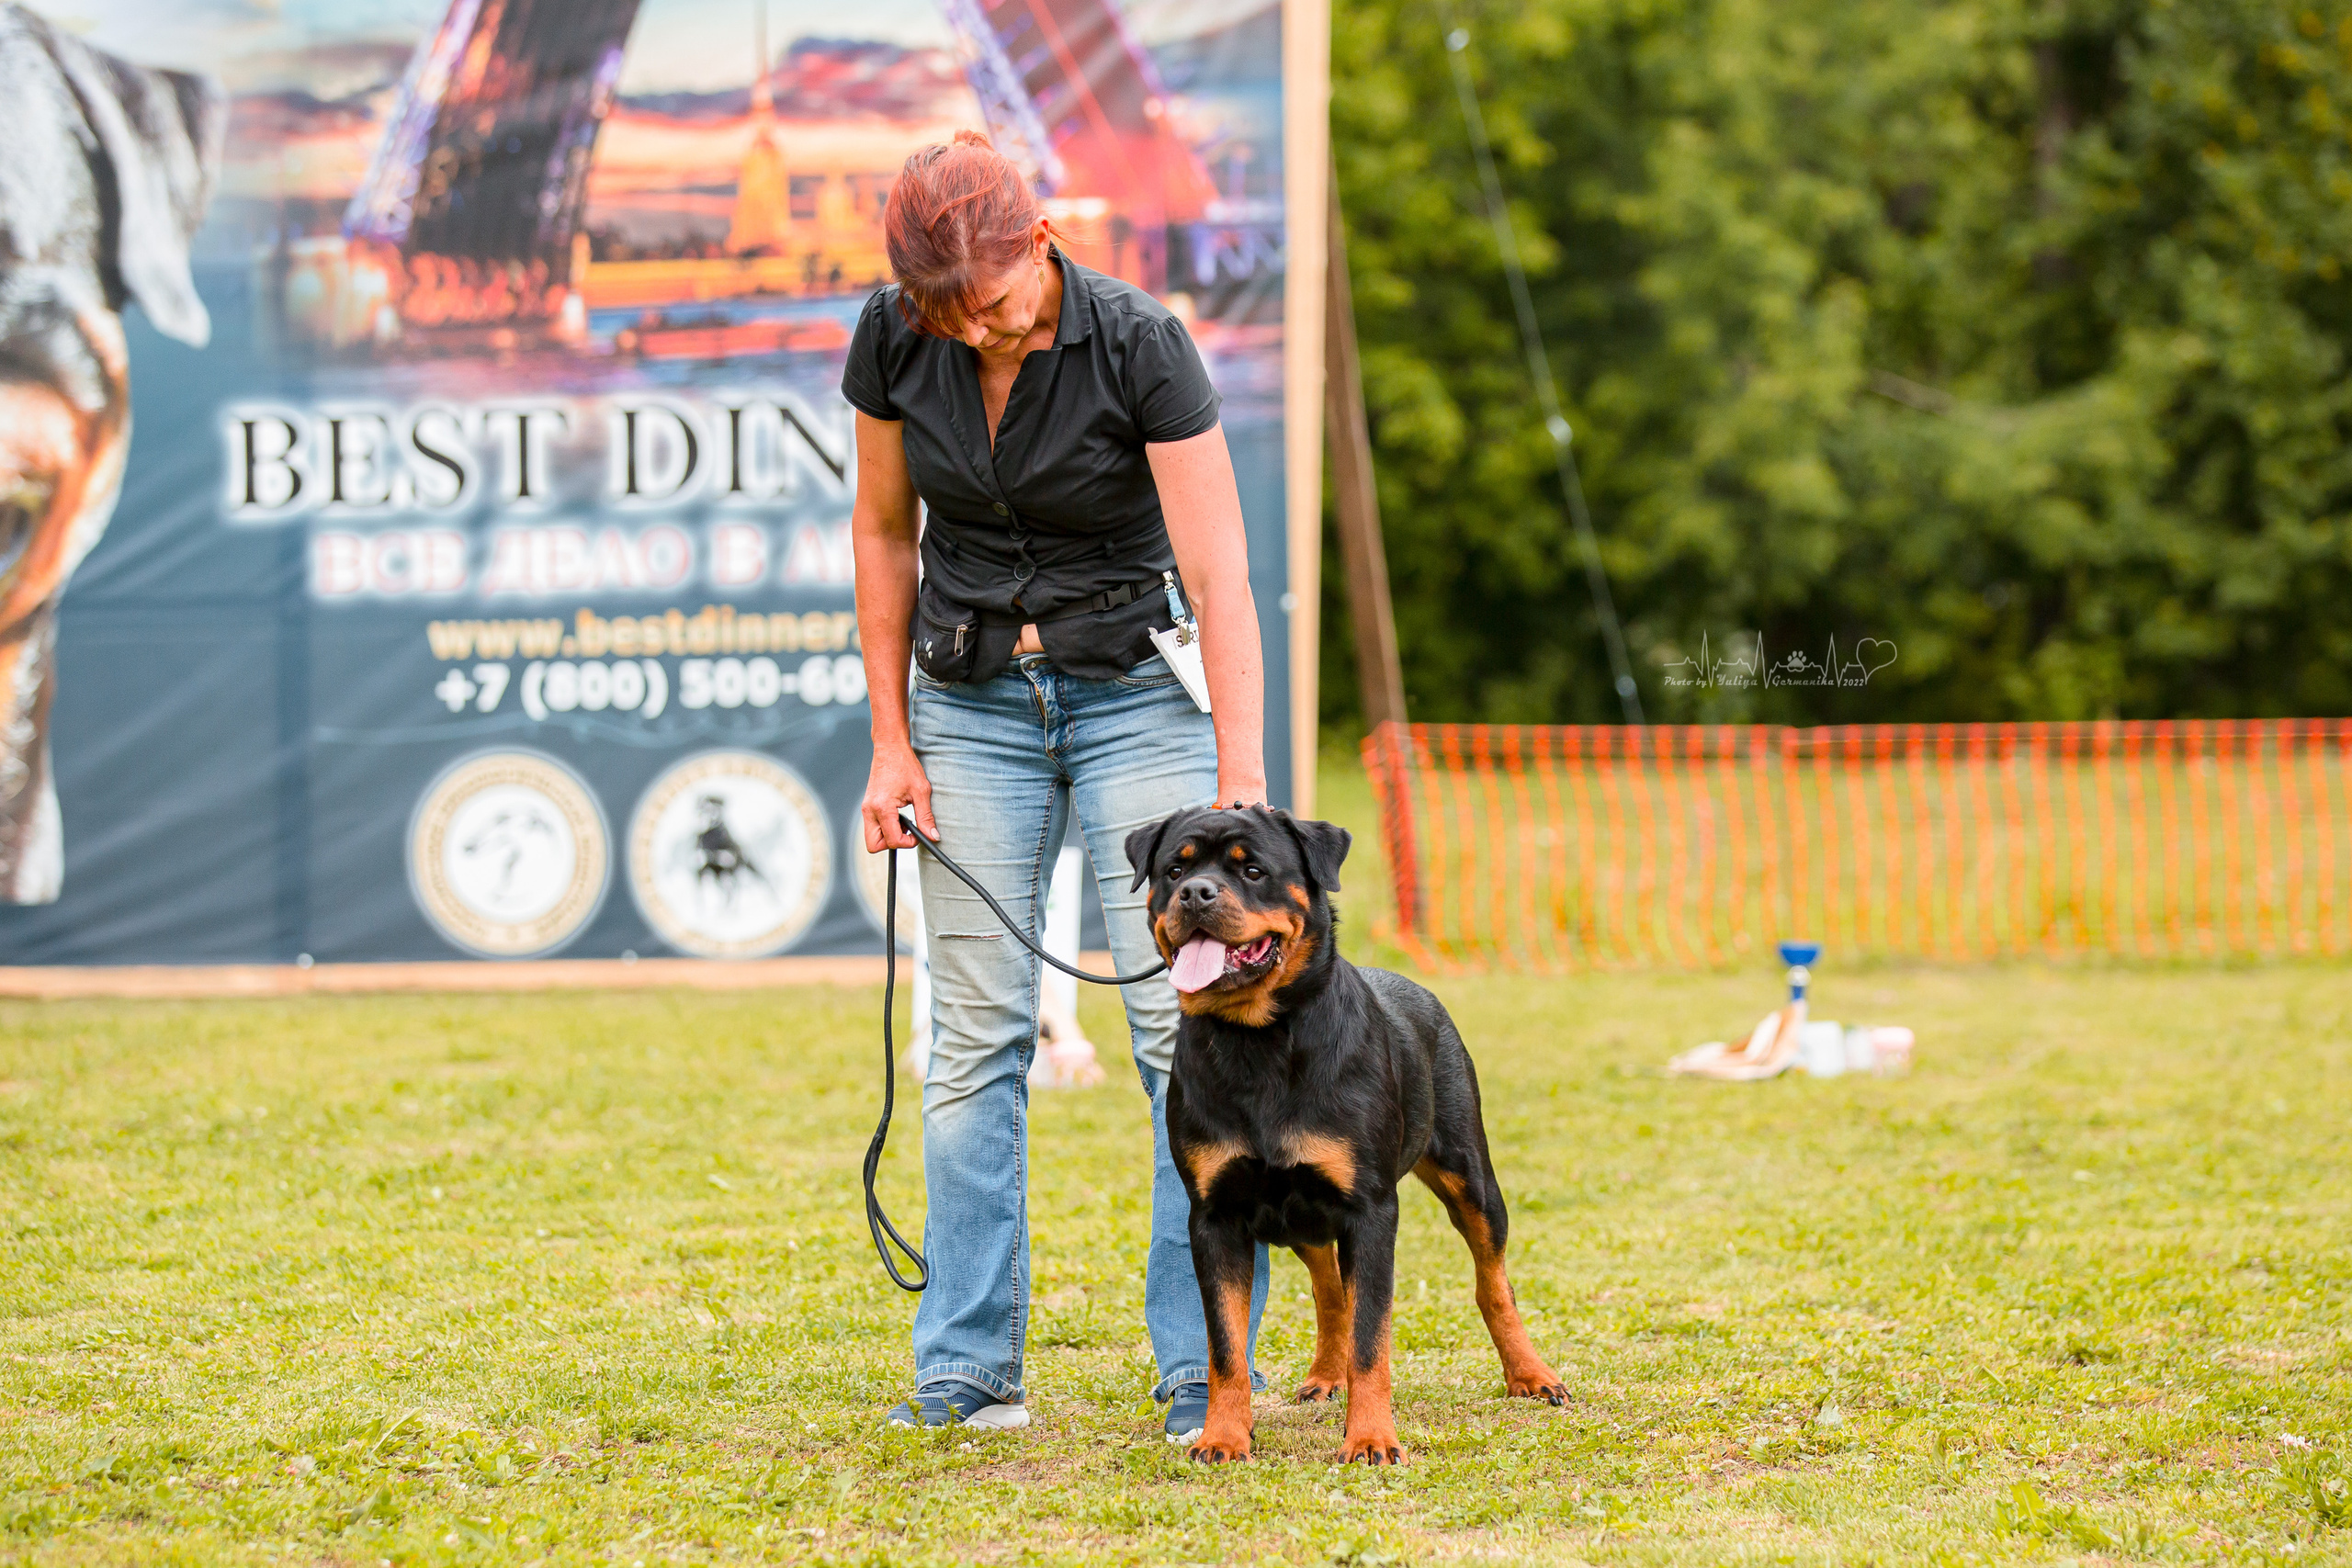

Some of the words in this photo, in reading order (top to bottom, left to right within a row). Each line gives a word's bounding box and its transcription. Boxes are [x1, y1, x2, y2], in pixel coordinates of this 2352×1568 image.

[230, 404, 567, 511] BEST
[711, 524, 765, 585] В
[435, 662, 511, 713] +7
[520, 658, 669, 721] (800)
